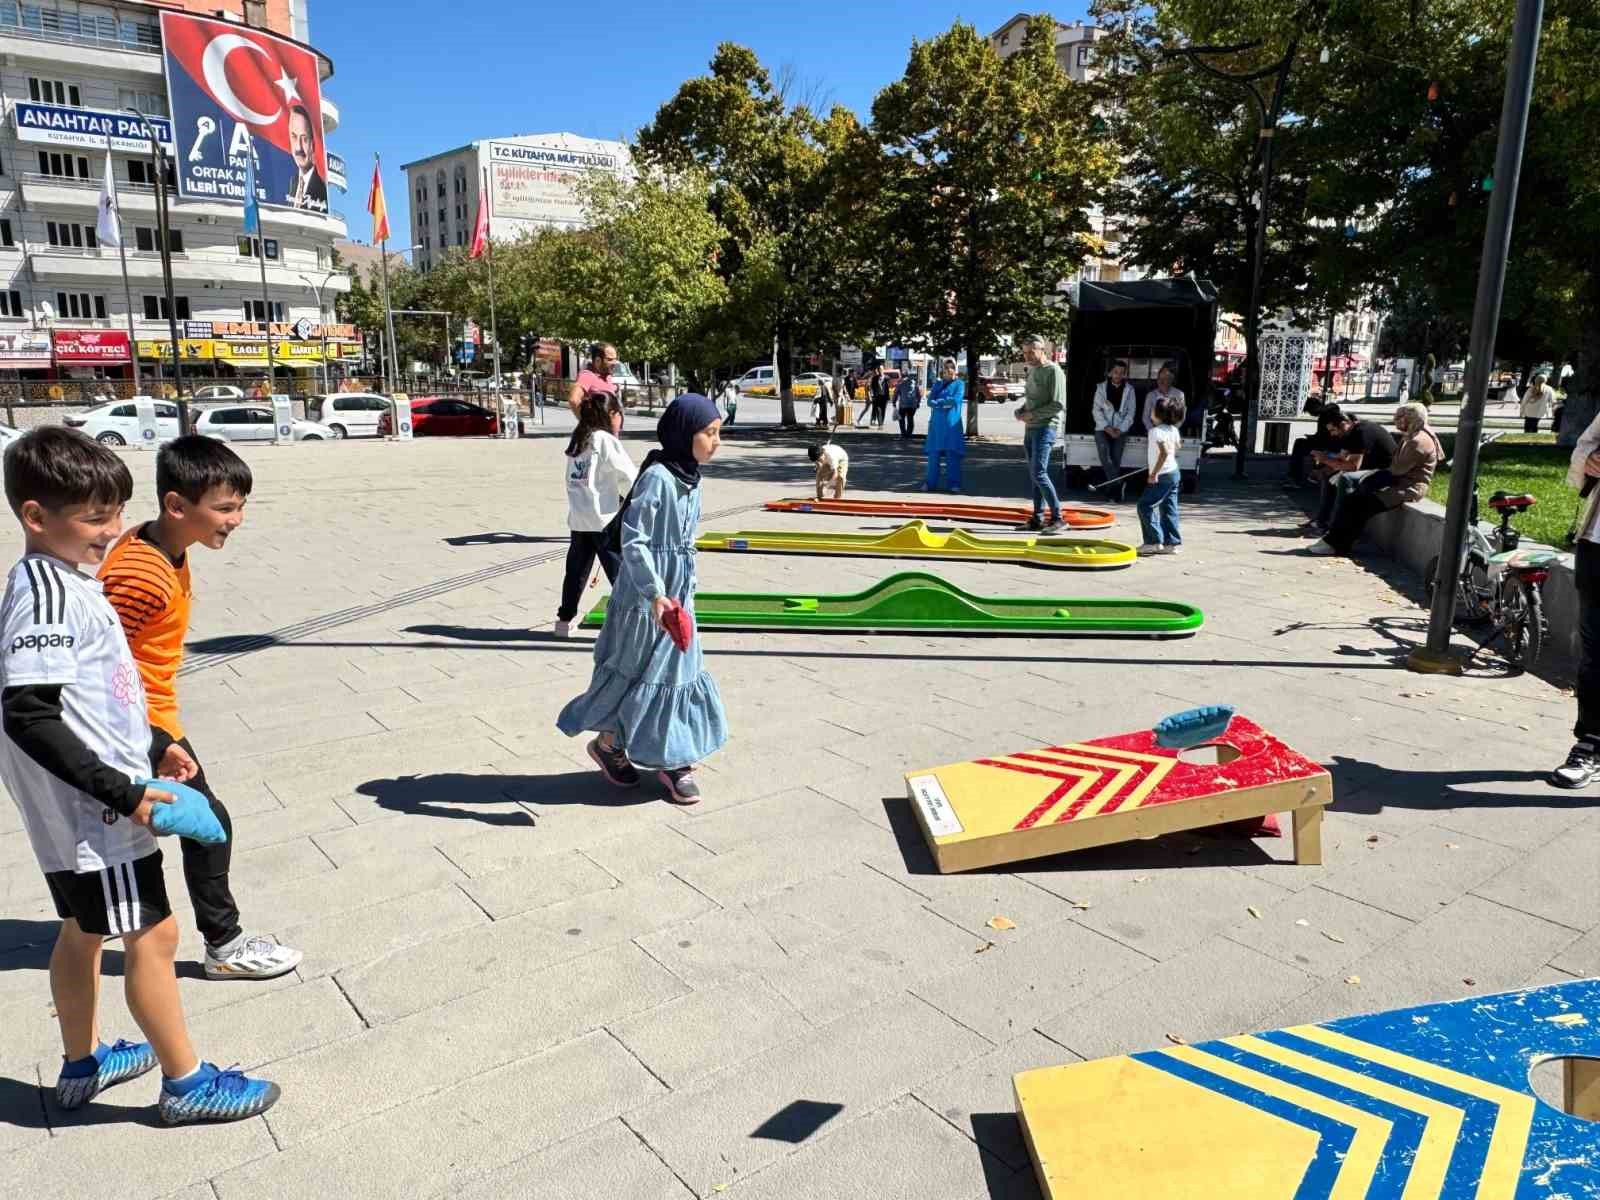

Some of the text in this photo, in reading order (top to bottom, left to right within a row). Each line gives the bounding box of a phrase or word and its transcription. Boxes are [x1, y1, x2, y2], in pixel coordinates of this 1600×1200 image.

[23, 109, 168, 140] ANAHTAR PARTİ
[99, 138, 148, 148] BŞKANLIĞI
[192, 165, 233, 180] ORTAK
[186, 177, 217, 194] İLERİ
[213, 321, 297, 336] EMLAK
[232, 344, 264, 355] EAGLE
[11, 633, 74, 654] papara
